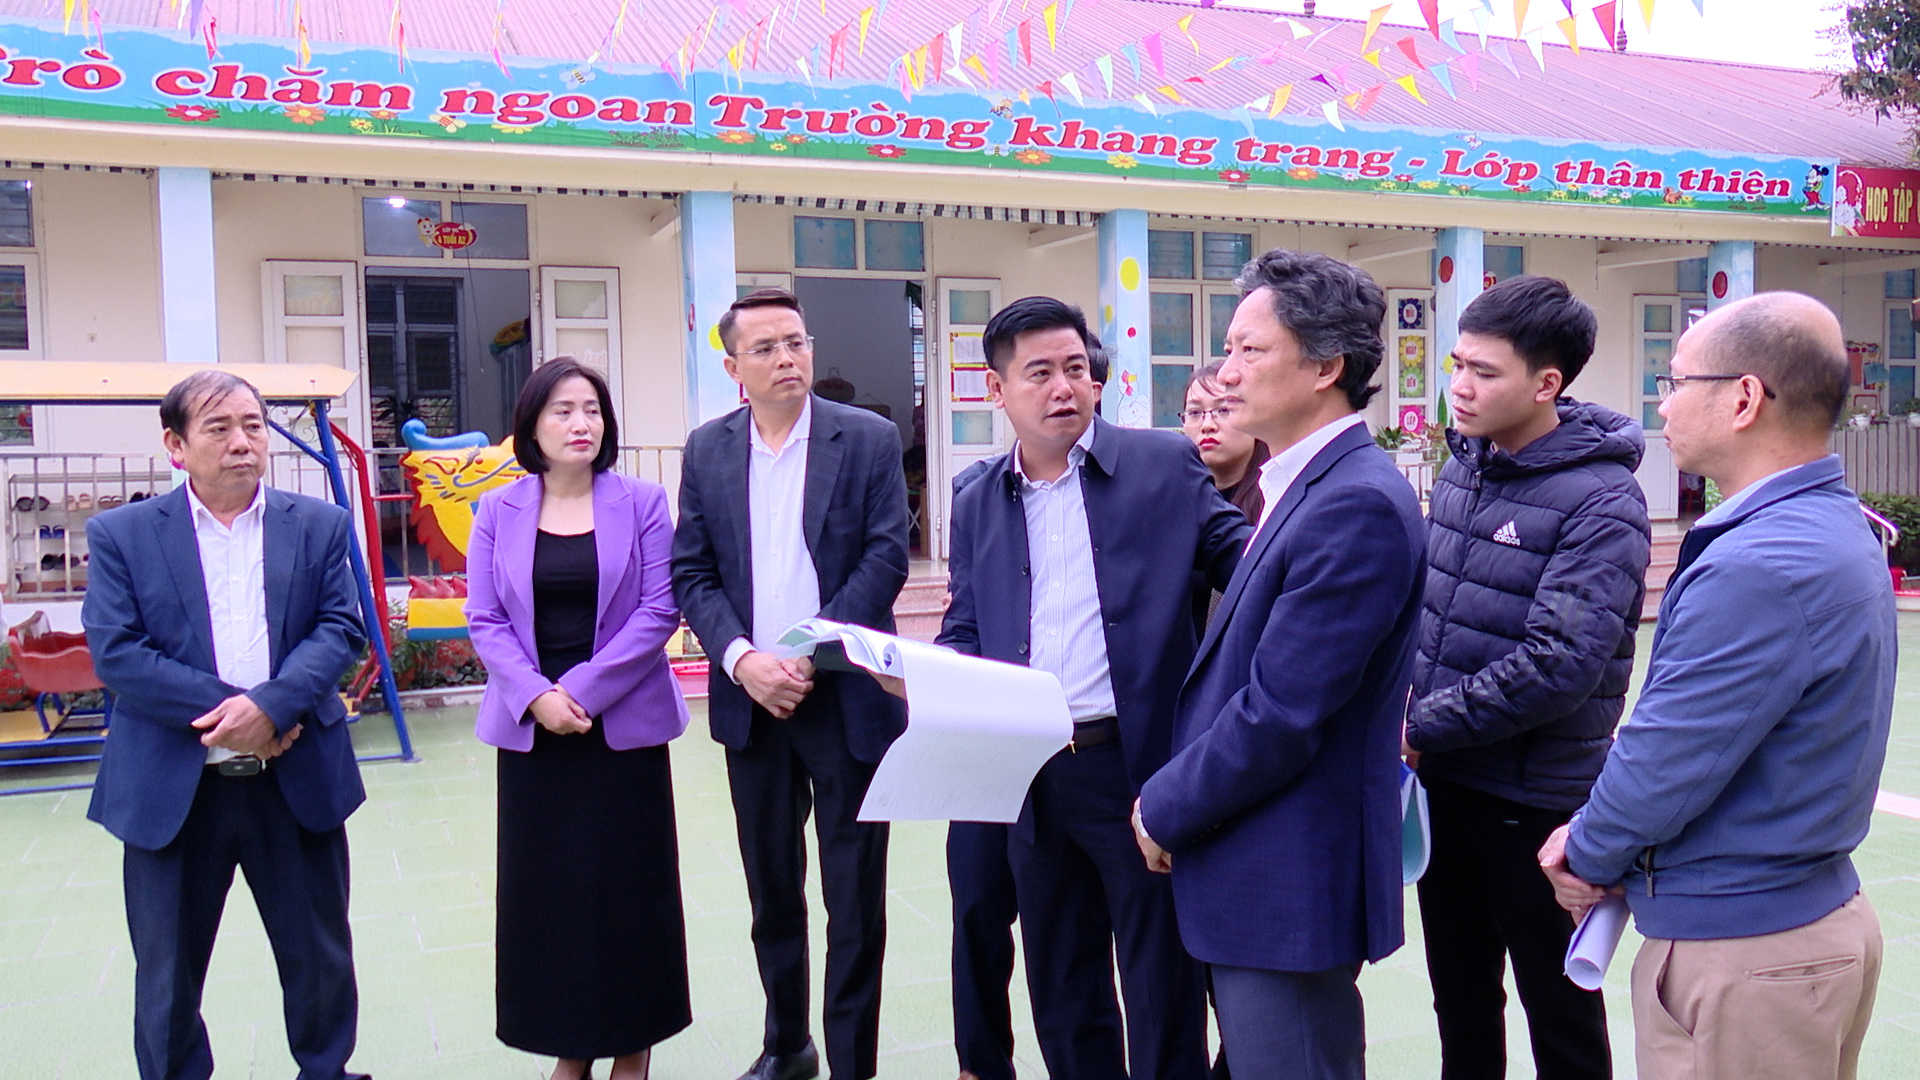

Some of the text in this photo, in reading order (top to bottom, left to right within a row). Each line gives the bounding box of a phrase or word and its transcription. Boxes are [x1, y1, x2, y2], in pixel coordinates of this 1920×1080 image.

[0, 46, 122, 90] rò
[155, 63, 412, 111] chăm
[442, 89, 694, 126] ngoan
[708, 95, 988, 150] Trường
[1010, 116, 1216, 166] khang
[1235, 138, 1394, 177] trang
[1439, 150, 1539, 187] Lớp
[1554, 160, 1662, 189] thân
[1678, 169, 1791, 200] thiện
[1865, 186, 1889, 230] HỌC
[1892, 181, 1914, 231] TẬP
[1493, 533, 1520, 546] adidas
